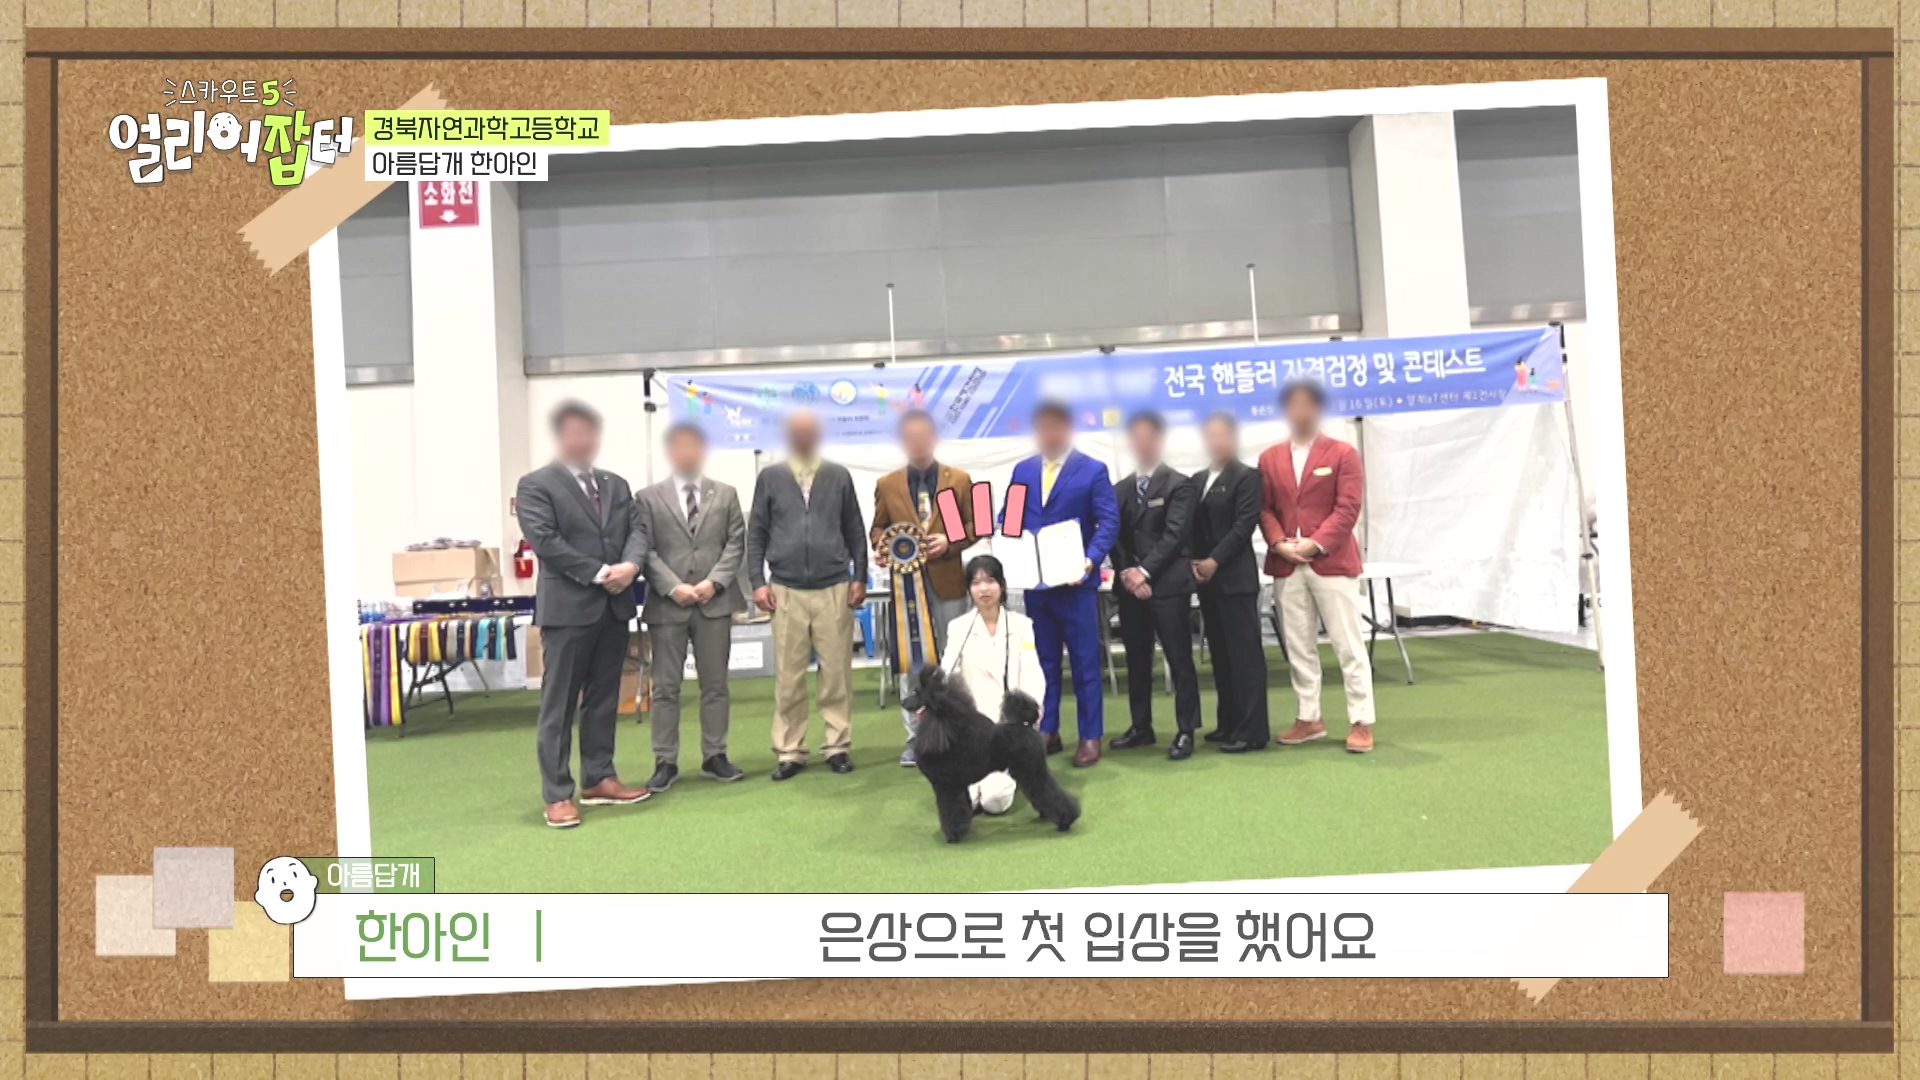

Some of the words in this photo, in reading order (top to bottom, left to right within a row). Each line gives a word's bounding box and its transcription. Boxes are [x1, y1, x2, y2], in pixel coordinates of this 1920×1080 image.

[1163, 365, 1206, 398] 전국
[1211, 359, 1277, 395] 핸들러
[1372, 352, 1397, 384] 및
[1402, 346, 1487, 383] 콘테스트
